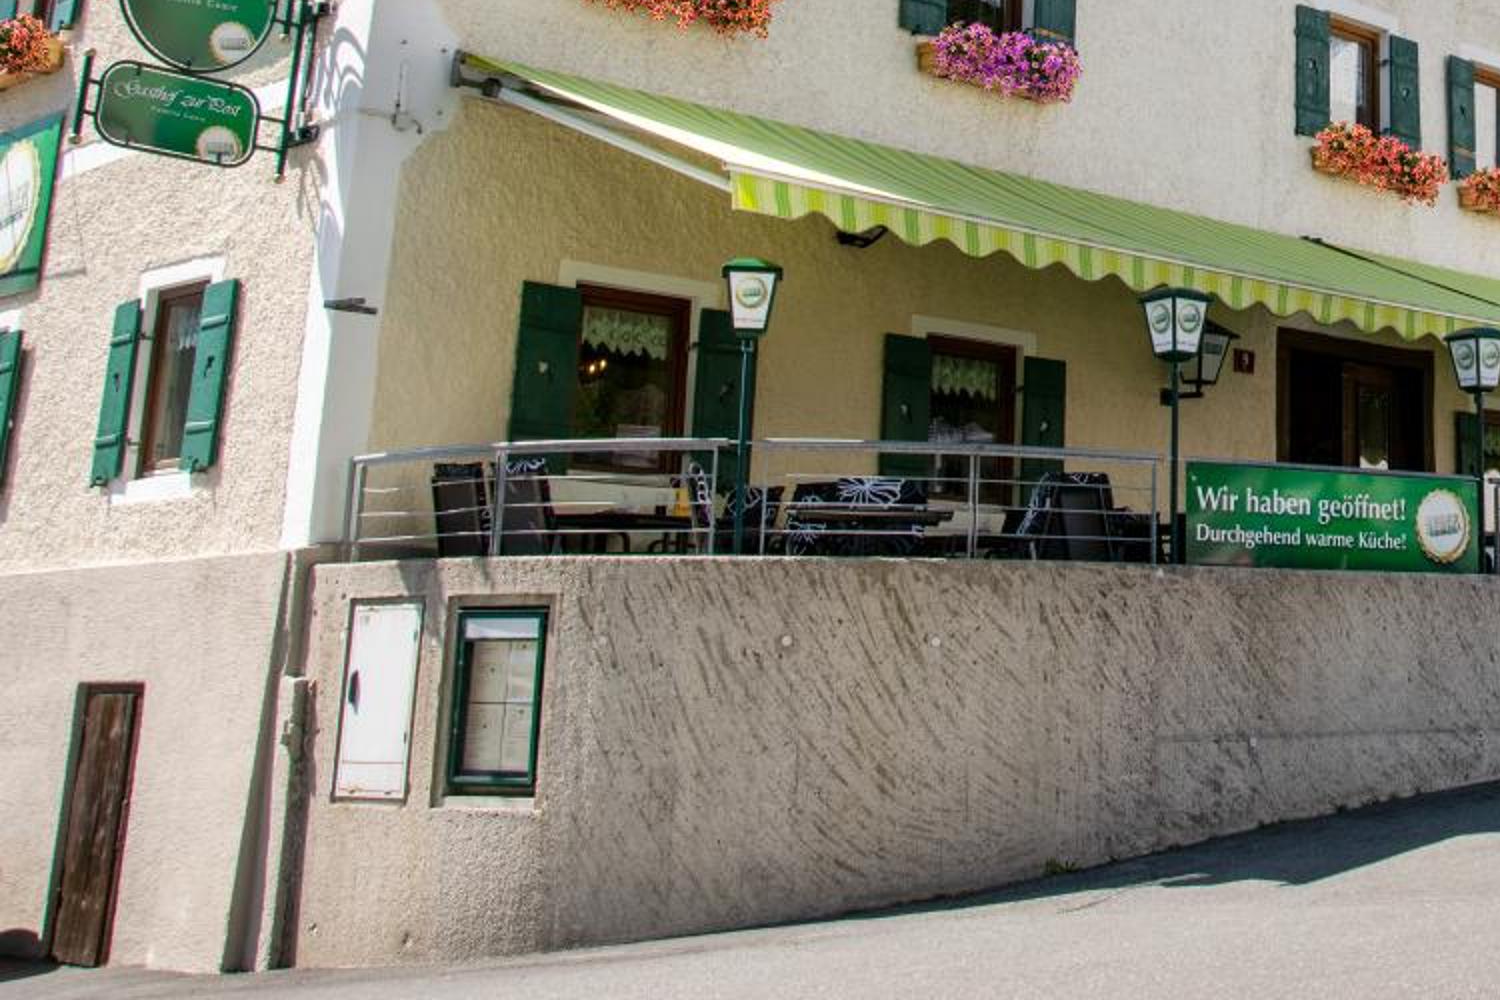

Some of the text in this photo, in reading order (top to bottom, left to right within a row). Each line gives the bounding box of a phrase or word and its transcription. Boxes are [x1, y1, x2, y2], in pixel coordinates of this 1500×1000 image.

[113, 79, 184, 107] Gasthof
[206, 94, 241, 117] Post
[1196, 485, 1239, 512] Wir
[1246, 487, 1311, 517] haben
[1317, 492, 1407, 526] geöffnet!
[1196, 524, 1408, 551] Durchgehend warme Küche!
